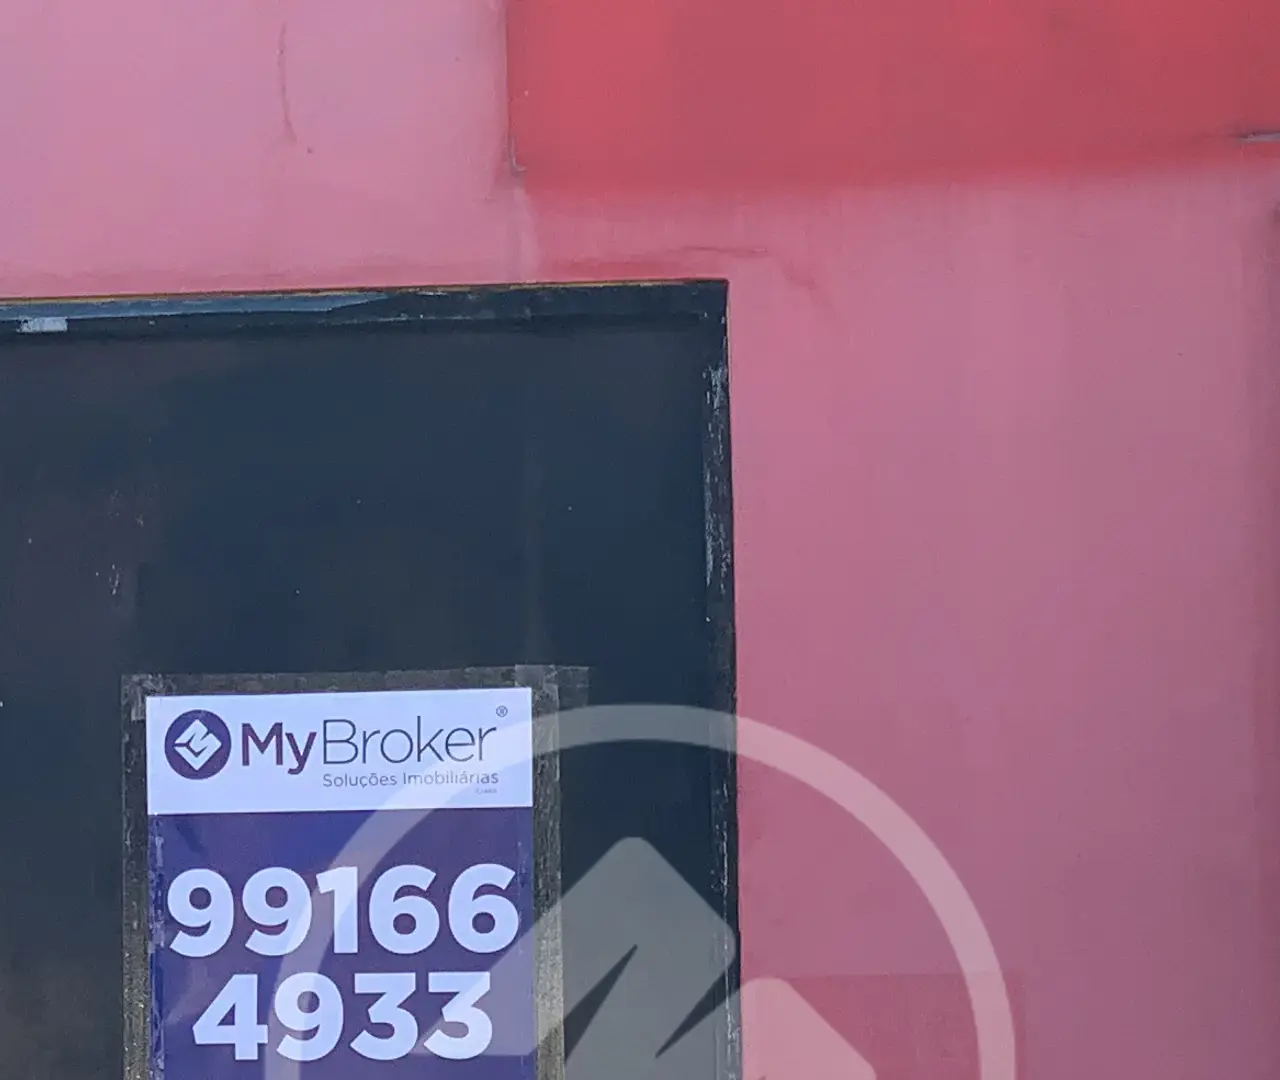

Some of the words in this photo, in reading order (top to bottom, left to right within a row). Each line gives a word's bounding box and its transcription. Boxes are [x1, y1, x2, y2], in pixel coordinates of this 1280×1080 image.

[241, 716, 496, 775] MyBroker
[323, 772, 397, 789] Soluções
[403, 768, 499, 786] Imobiliárias
[167, 864, 519, 957] 99166
[192, 971, 493, 1061] 4933
